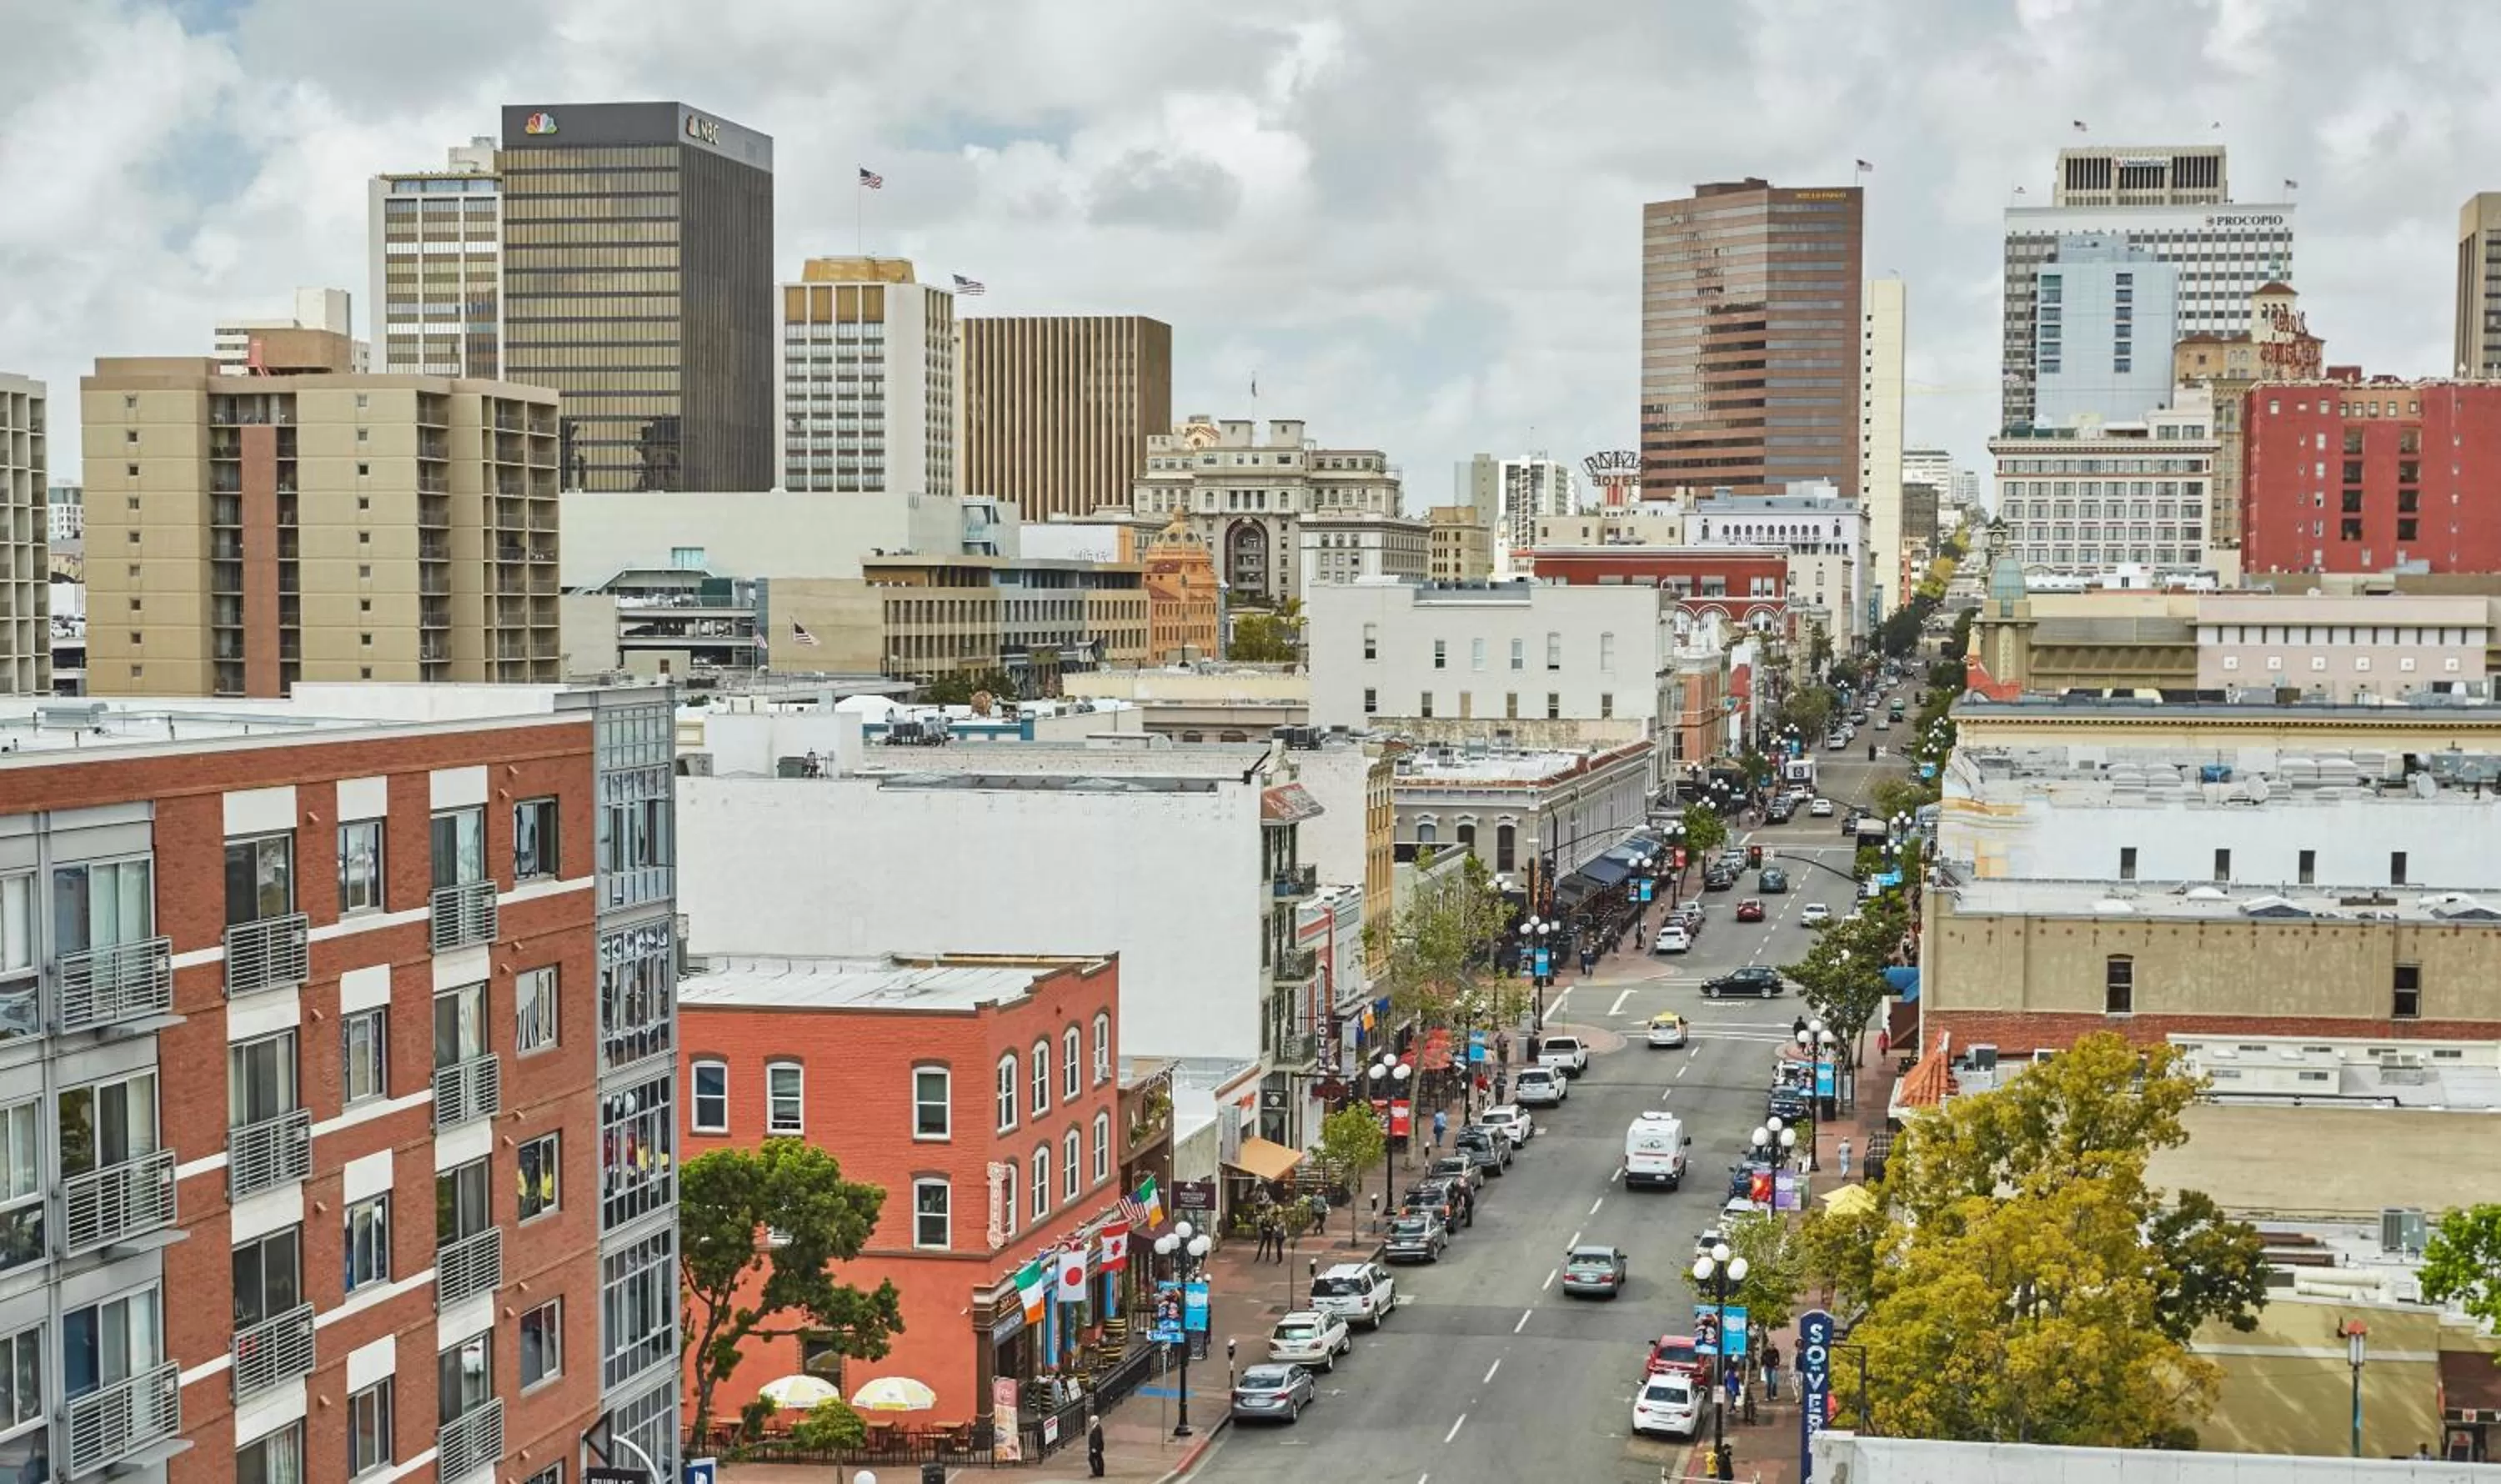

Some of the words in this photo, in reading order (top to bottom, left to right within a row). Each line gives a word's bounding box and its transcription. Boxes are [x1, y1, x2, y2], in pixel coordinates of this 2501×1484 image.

[2217, 214, 2283, 227] PROCOPIO
[1318, 1015, 1327, 1068] HOTEL
[1806, 1323, 1826, 1484] SOVER
